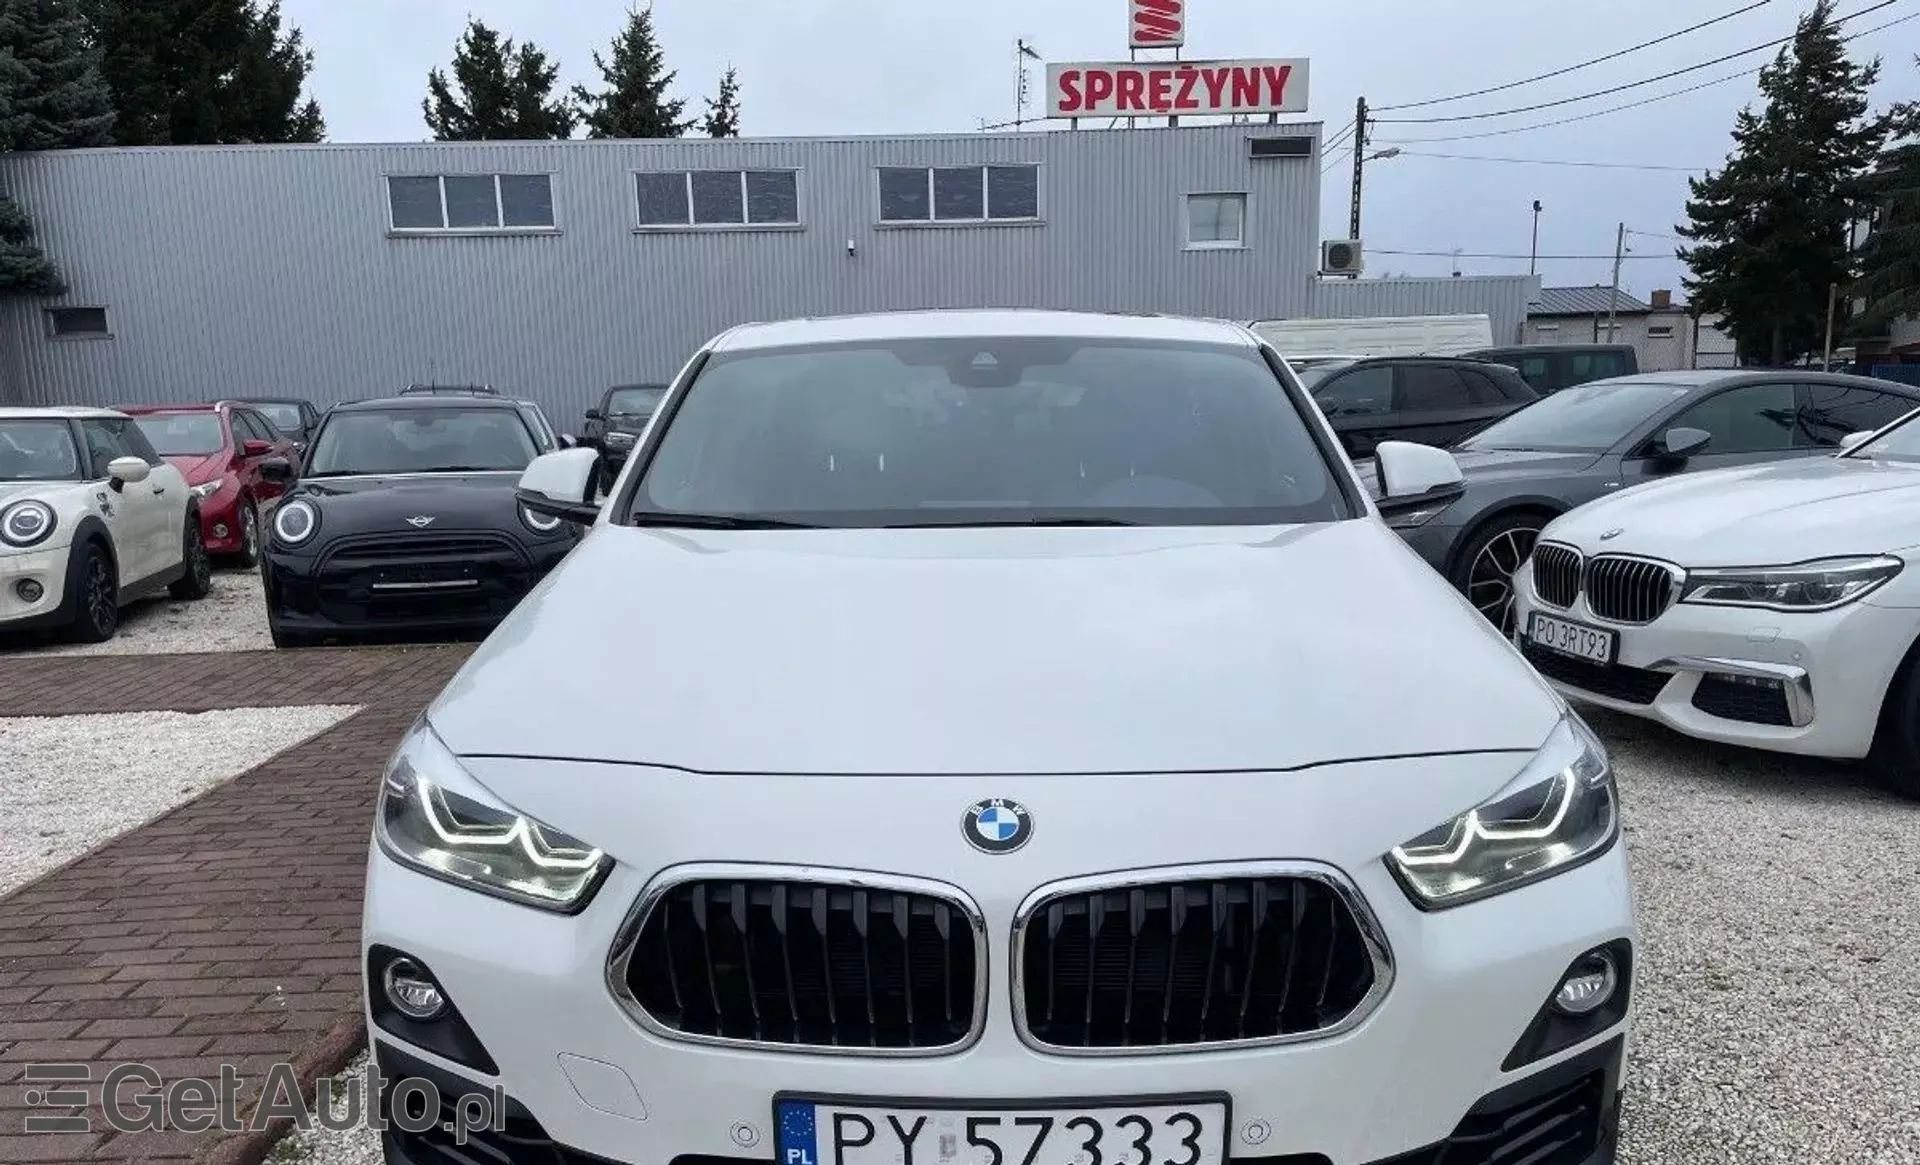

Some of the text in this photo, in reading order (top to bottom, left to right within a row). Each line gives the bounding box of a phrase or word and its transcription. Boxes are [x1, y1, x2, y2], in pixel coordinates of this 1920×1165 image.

[1058, 65, 1292, 112] SPRĘŻYNY
[1559, 624, 1607, 658] 3RT93
[967, 797, 1027, 816] BMW
[833, 1111, 1203, 1165] PY 57333
[787, 1148, 812, 1164] PL
